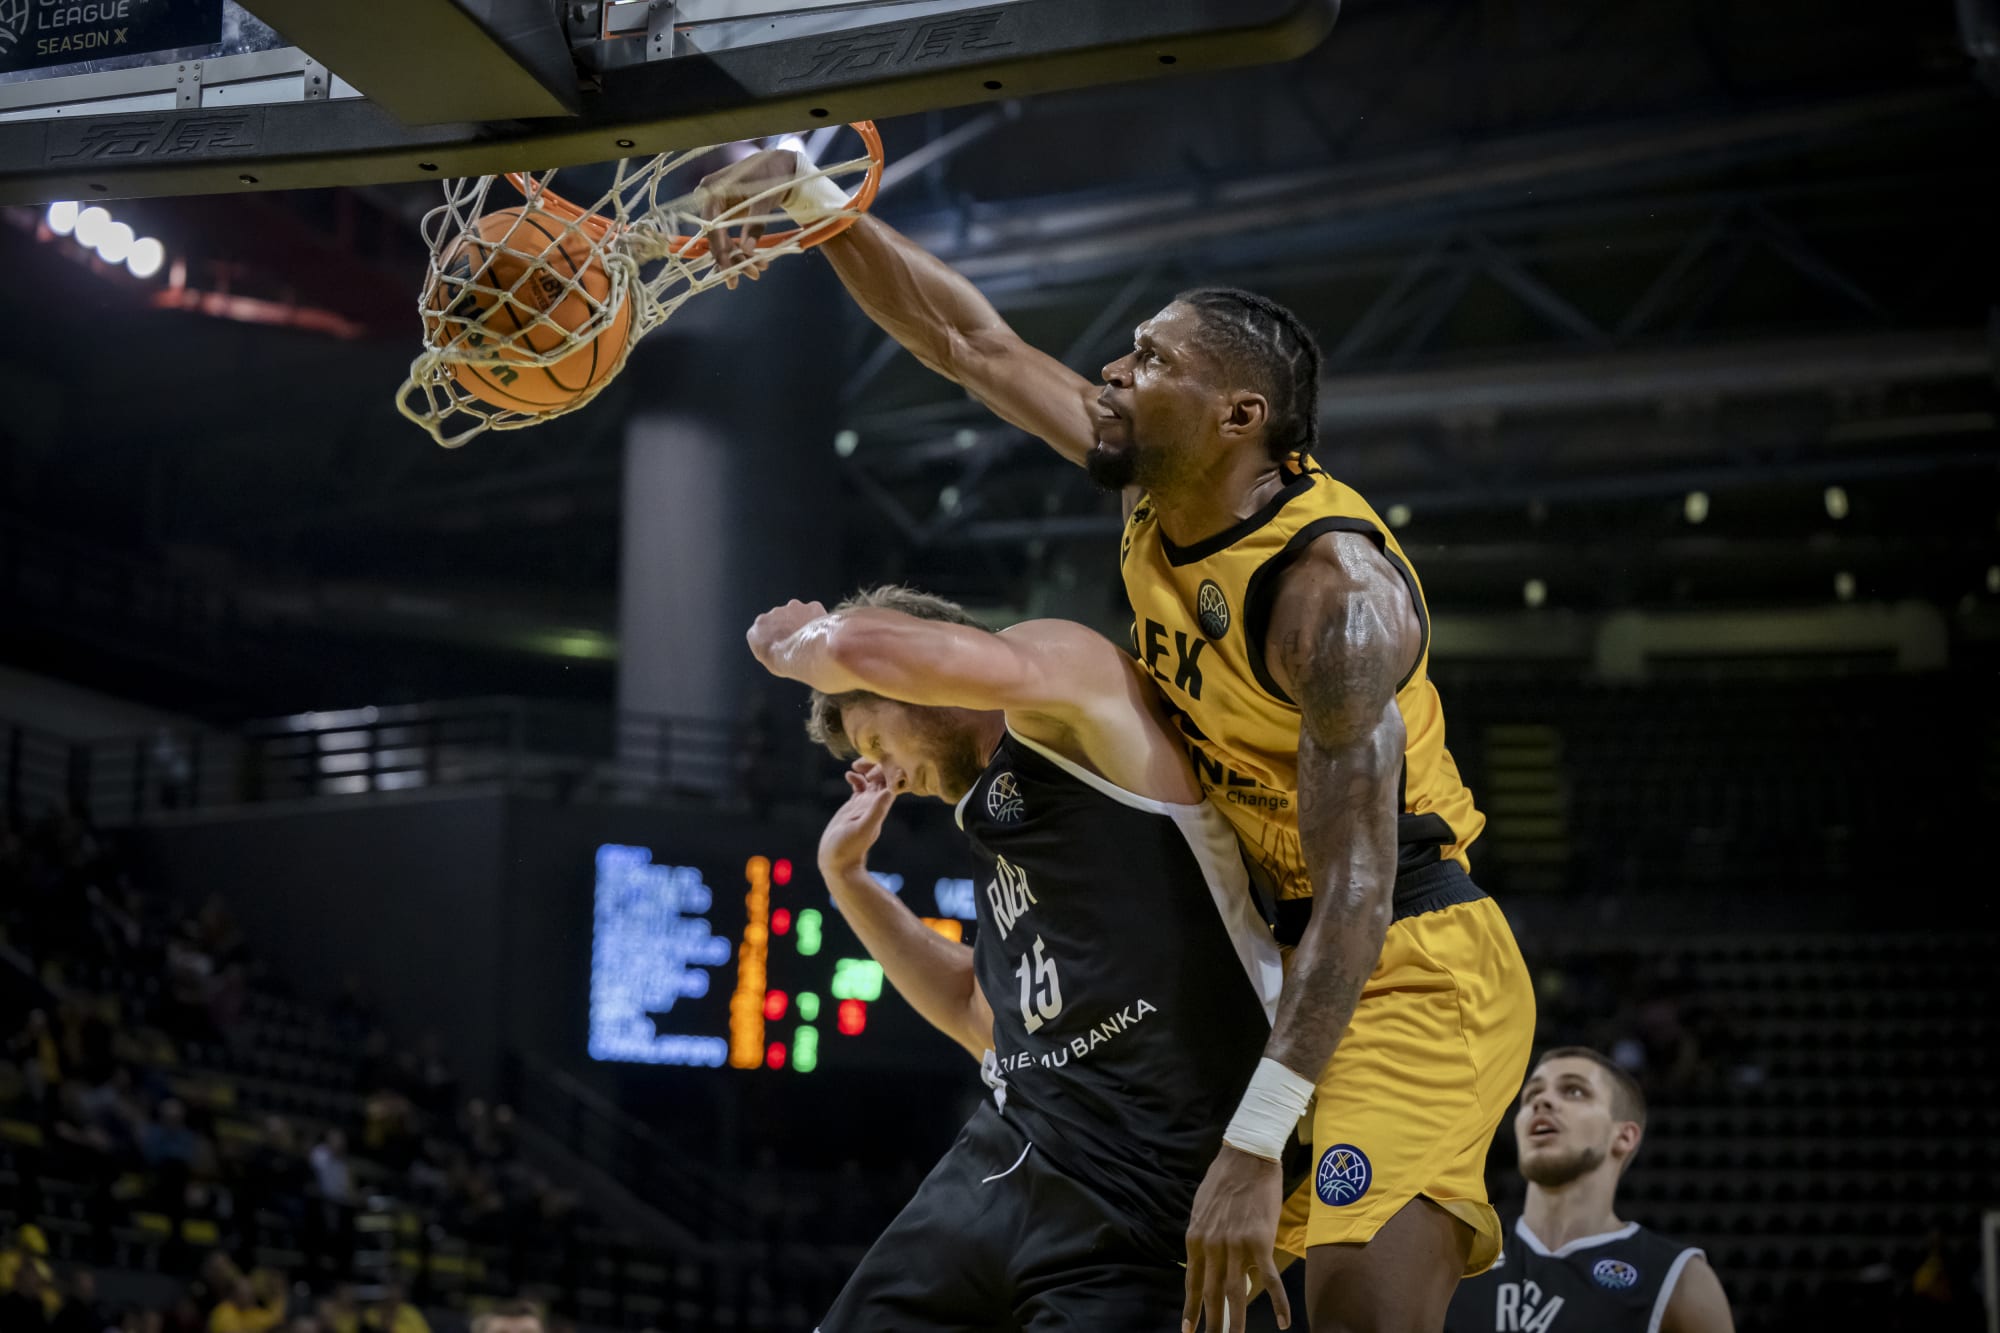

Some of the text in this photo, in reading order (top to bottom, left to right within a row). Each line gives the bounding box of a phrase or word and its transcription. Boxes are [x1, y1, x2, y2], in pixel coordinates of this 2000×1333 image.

[38, 1, 129, 30] LEAGUE
[37, 27, 129, 55] SEASON X
[1226, 790, 1289, 811] Change
[1015, 934, 1063, 1035] 15
[1070, 999, 1158, 1058] BANKA
